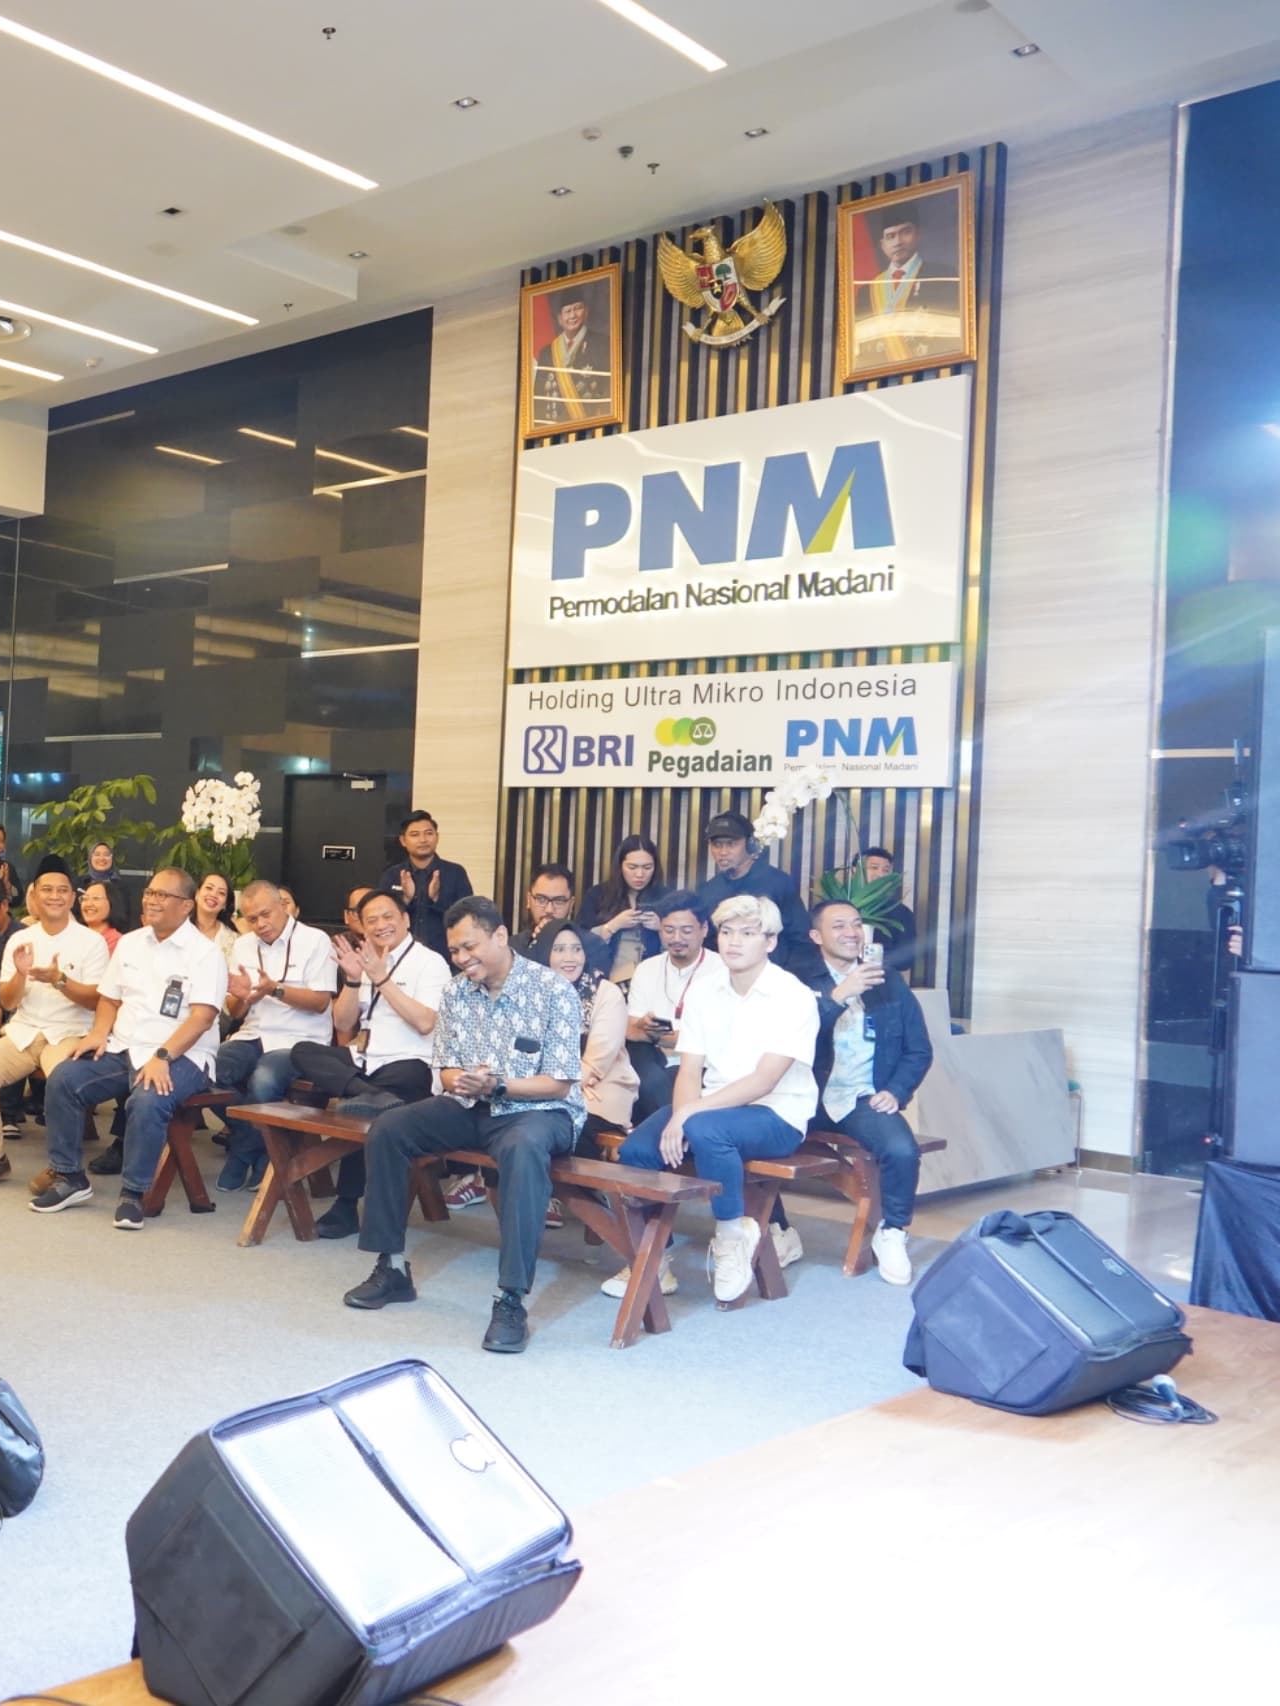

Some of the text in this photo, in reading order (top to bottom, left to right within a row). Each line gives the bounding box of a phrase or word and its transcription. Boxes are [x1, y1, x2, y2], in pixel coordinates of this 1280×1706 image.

[551, 440, 896, 581] PNM
[549, 564, 895, 619] Permodalan Nasional Madani
[528, 673, 917, 713] Holding Ultra Mikro Indonesia
[572, 734, 635, 767] BRI
[785, 716, 919, 758] PNM
[647, 748, 773, 778] Pegadaian
